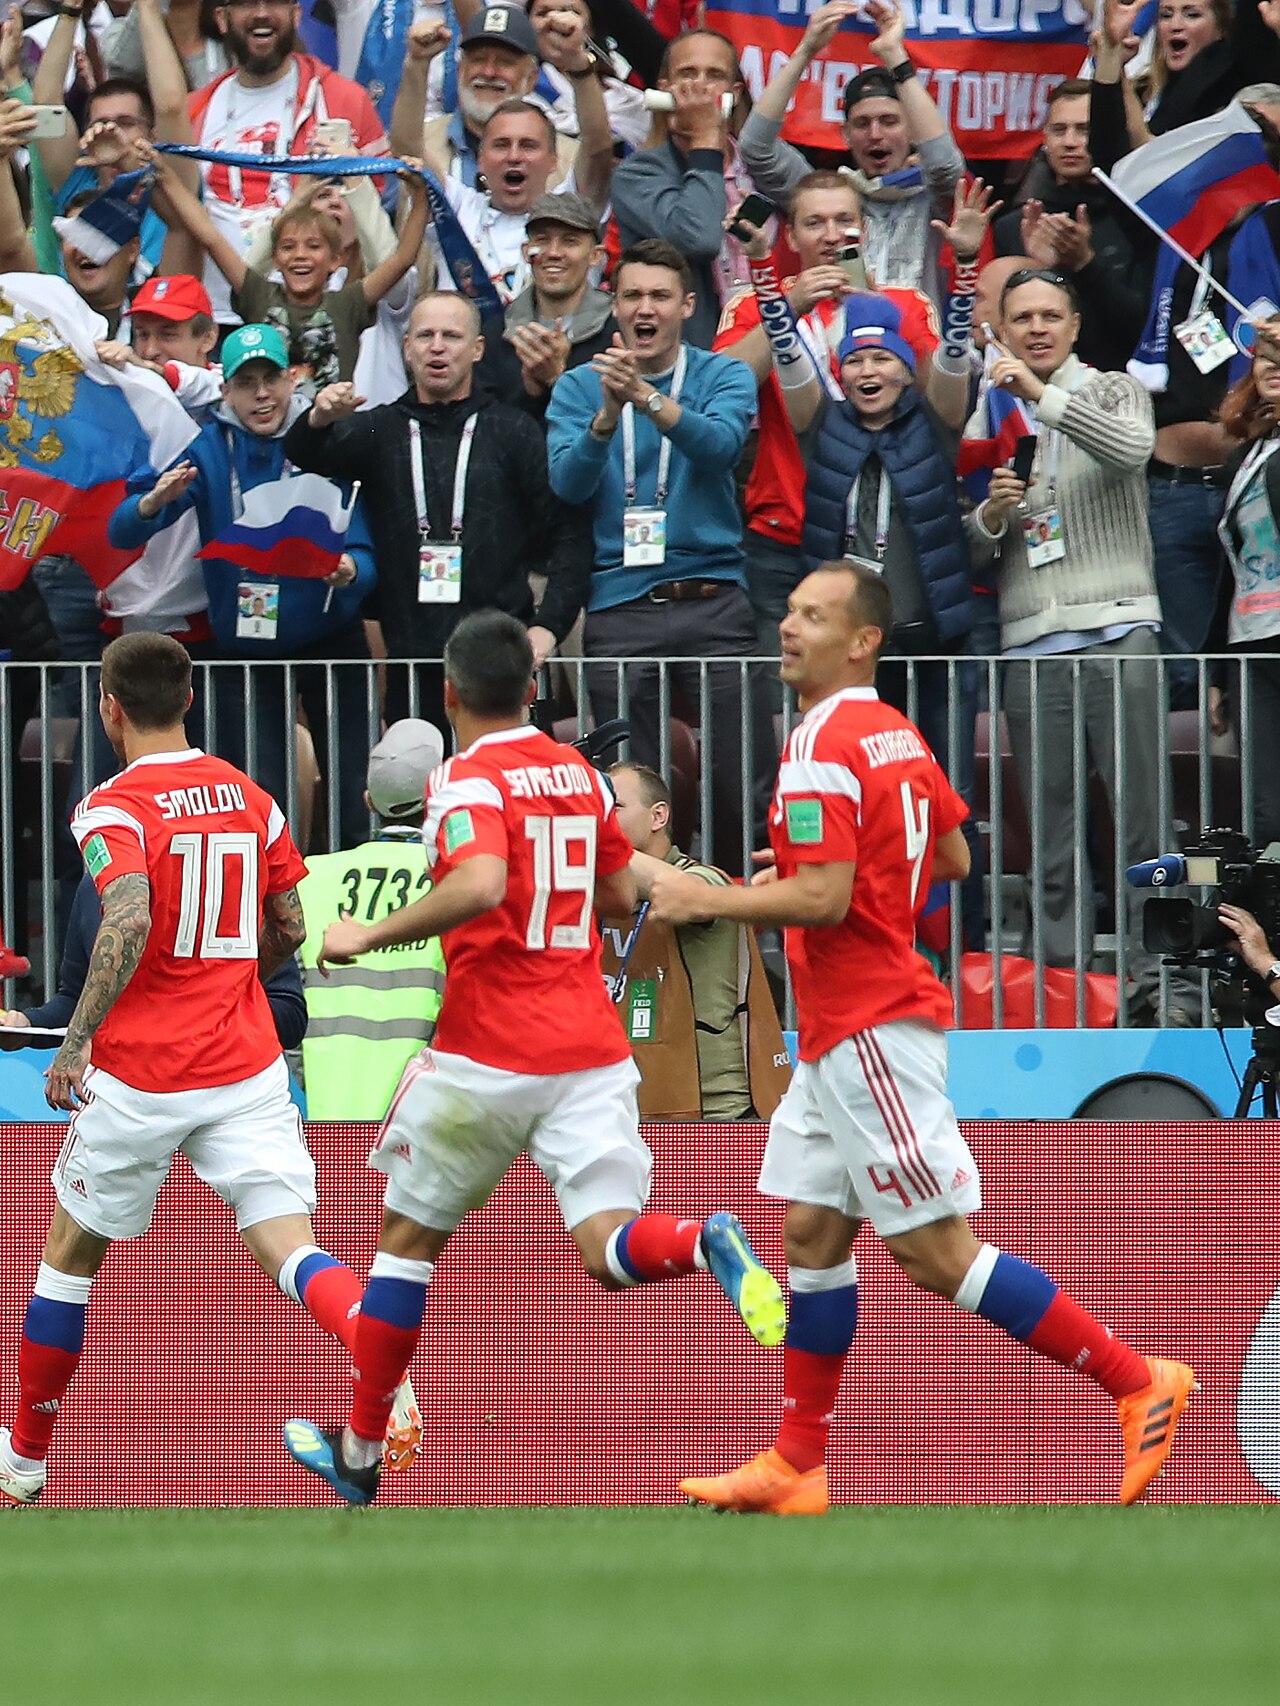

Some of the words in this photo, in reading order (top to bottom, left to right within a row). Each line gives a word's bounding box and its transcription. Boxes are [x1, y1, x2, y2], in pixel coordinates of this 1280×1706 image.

[752, 265, 802, 366] РОССИЯ
[944, 258, 981, 358] РОССИЯ
[153, 783, 247, 820] SMOLOV
[900, 780, 930, 910] 4
[169, 832, 259, 959] 10
[524, 815, 598, 950] 19
[866, 1164, 913, 1208] 4
